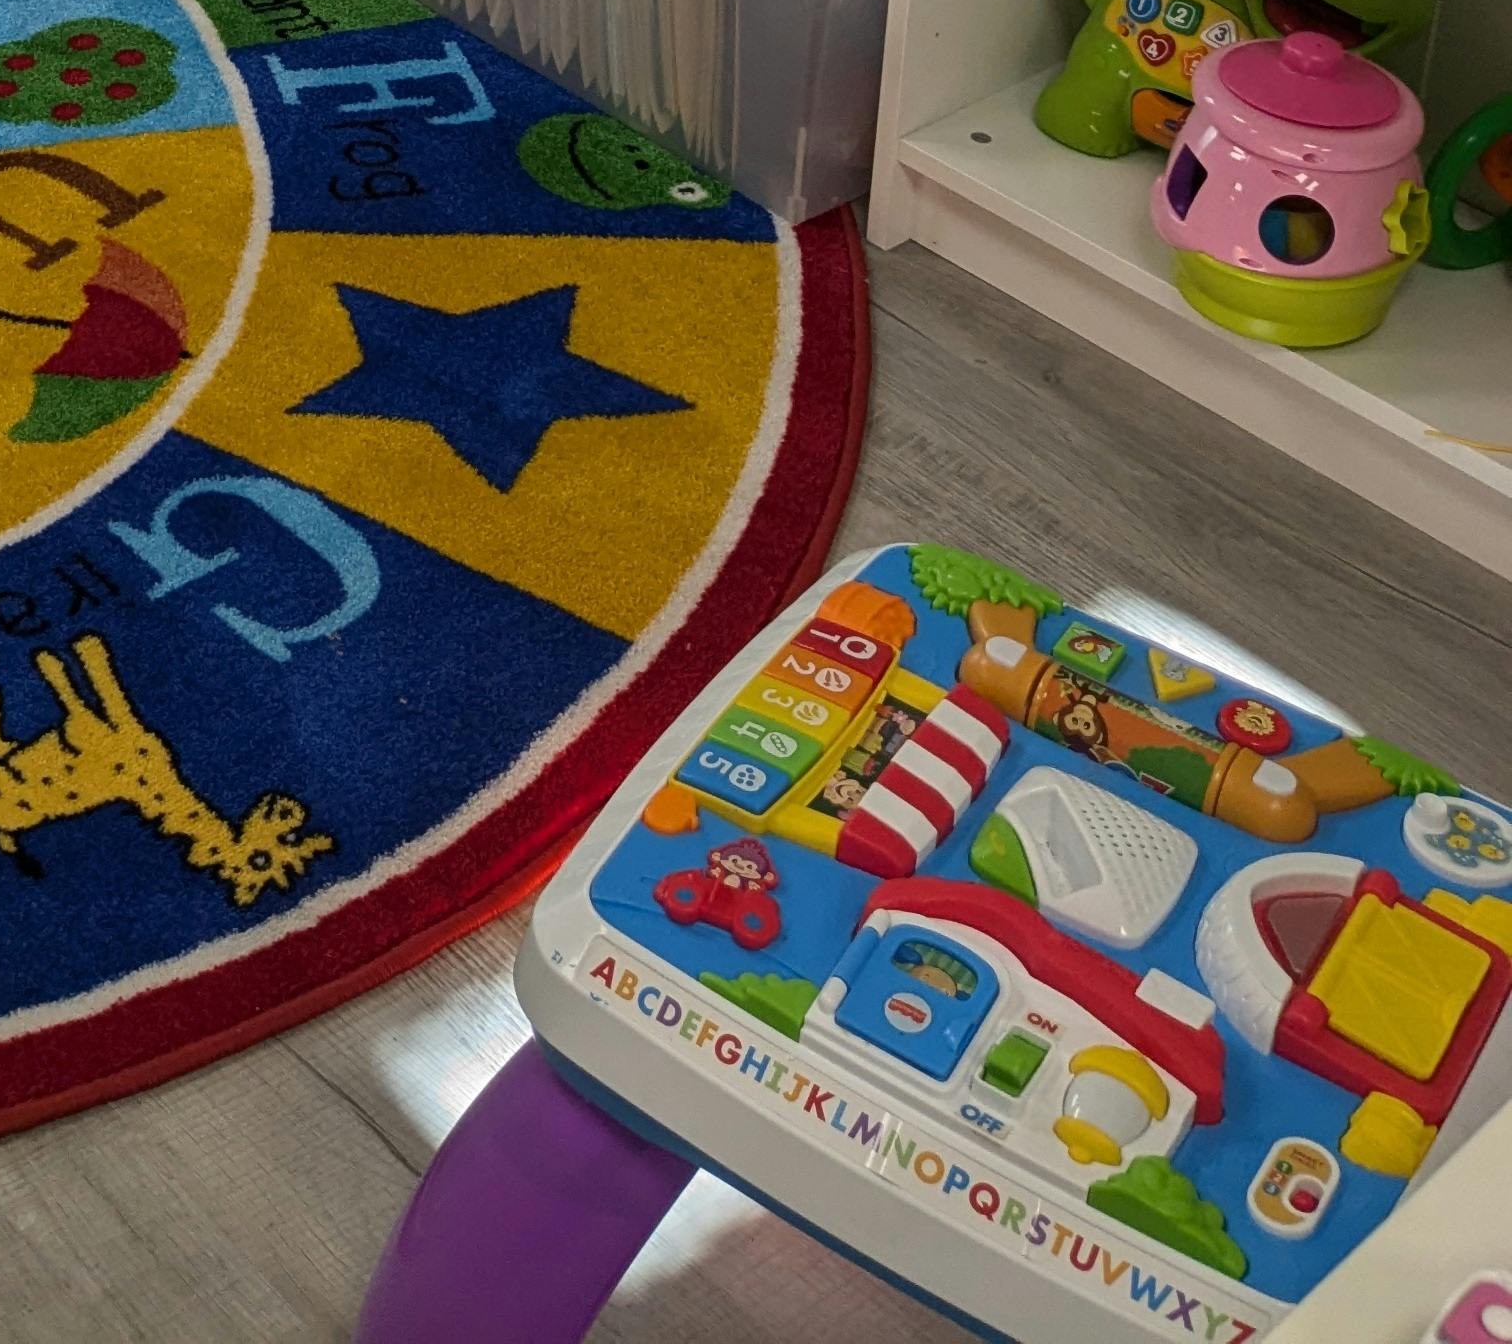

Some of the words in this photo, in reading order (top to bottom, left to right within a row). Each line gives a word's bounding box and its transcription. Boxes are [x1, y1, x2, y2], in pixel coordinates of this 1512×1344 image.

[261, 41, 497, 204] Frog
[781, 654, 817, 676] 2
[698, 750, 733, 775] 5
[1026, 1011, 1059, 1034] ON
[959, 1103, 1006, 1134] OFF
